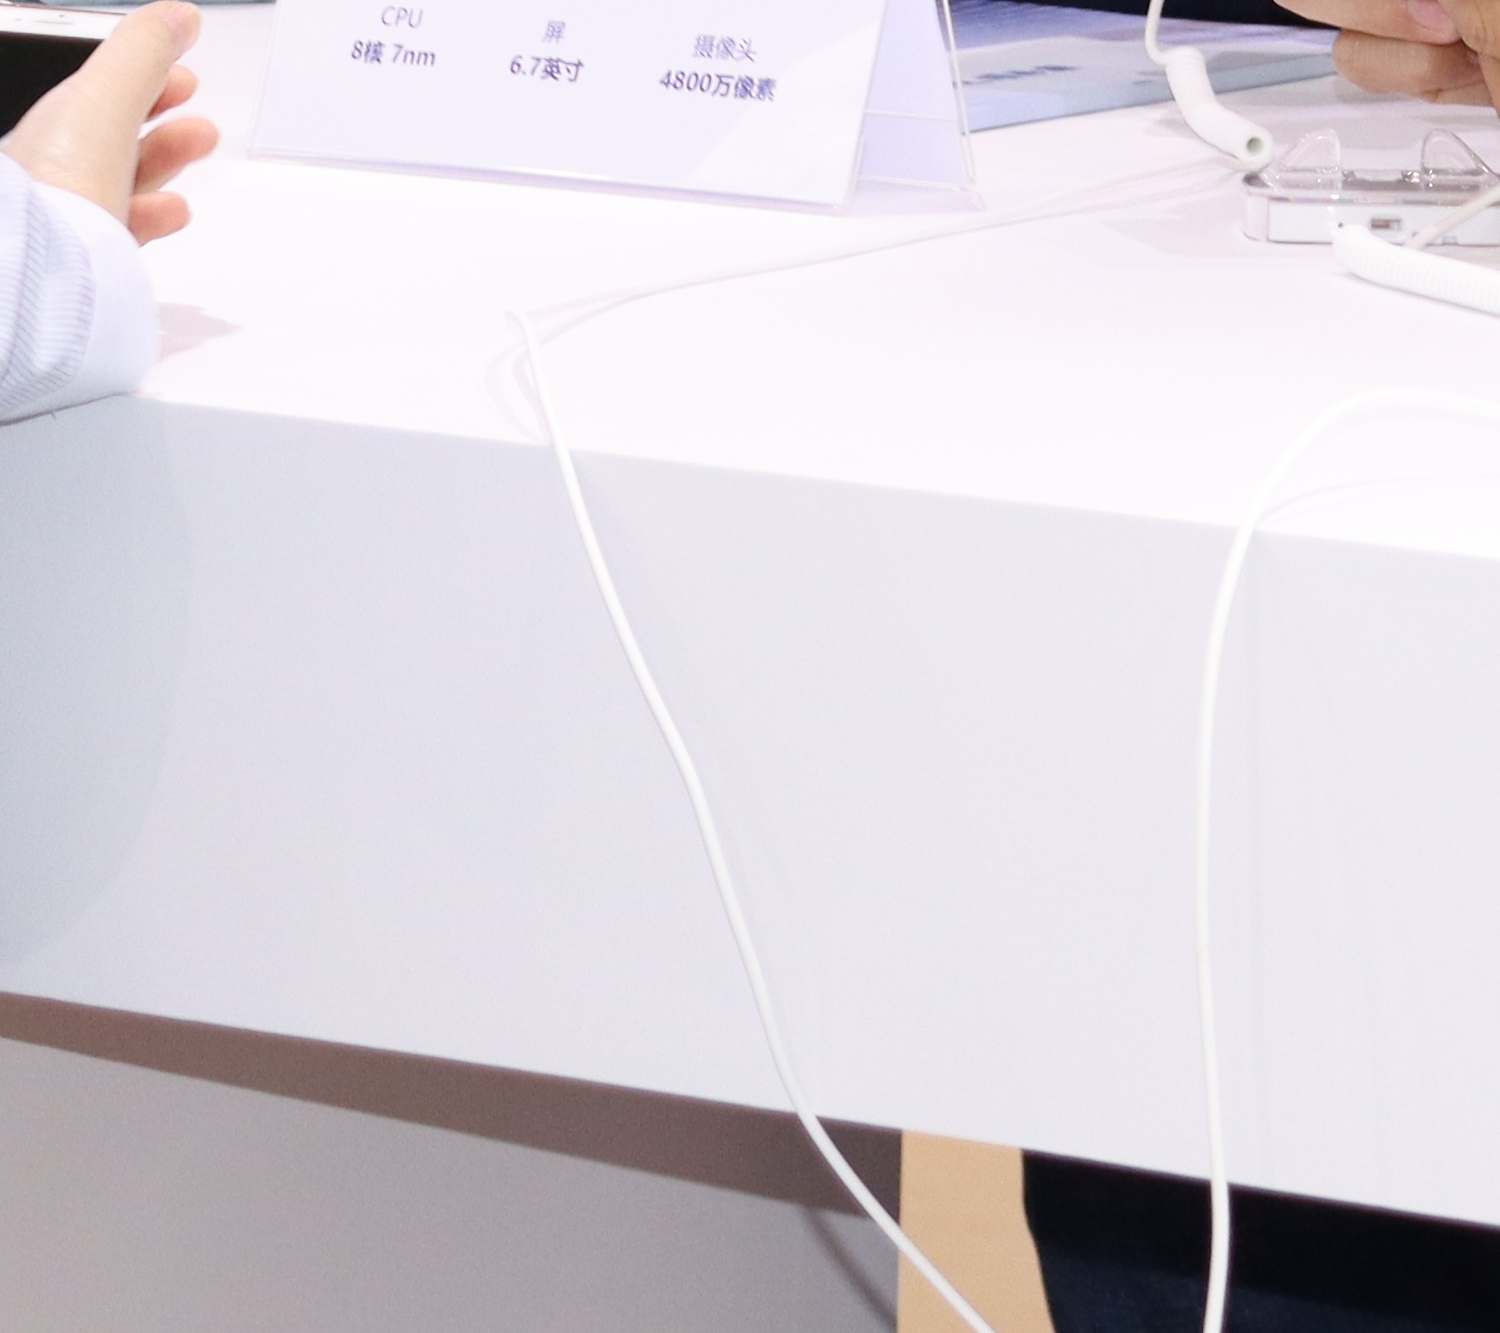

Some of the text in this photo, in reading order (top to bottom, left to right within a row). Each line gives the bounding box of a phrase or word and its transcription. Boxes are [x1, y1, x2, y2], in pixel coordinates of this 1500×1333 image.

[380, 4, 423, 29] CPU
[543, 20, 566, 44] 屏
[692, 34, 756, 63] 摄像头
[509, 53, 584, 84] 6.7英寸
[659, 70, 777, 102] 4800万像素
